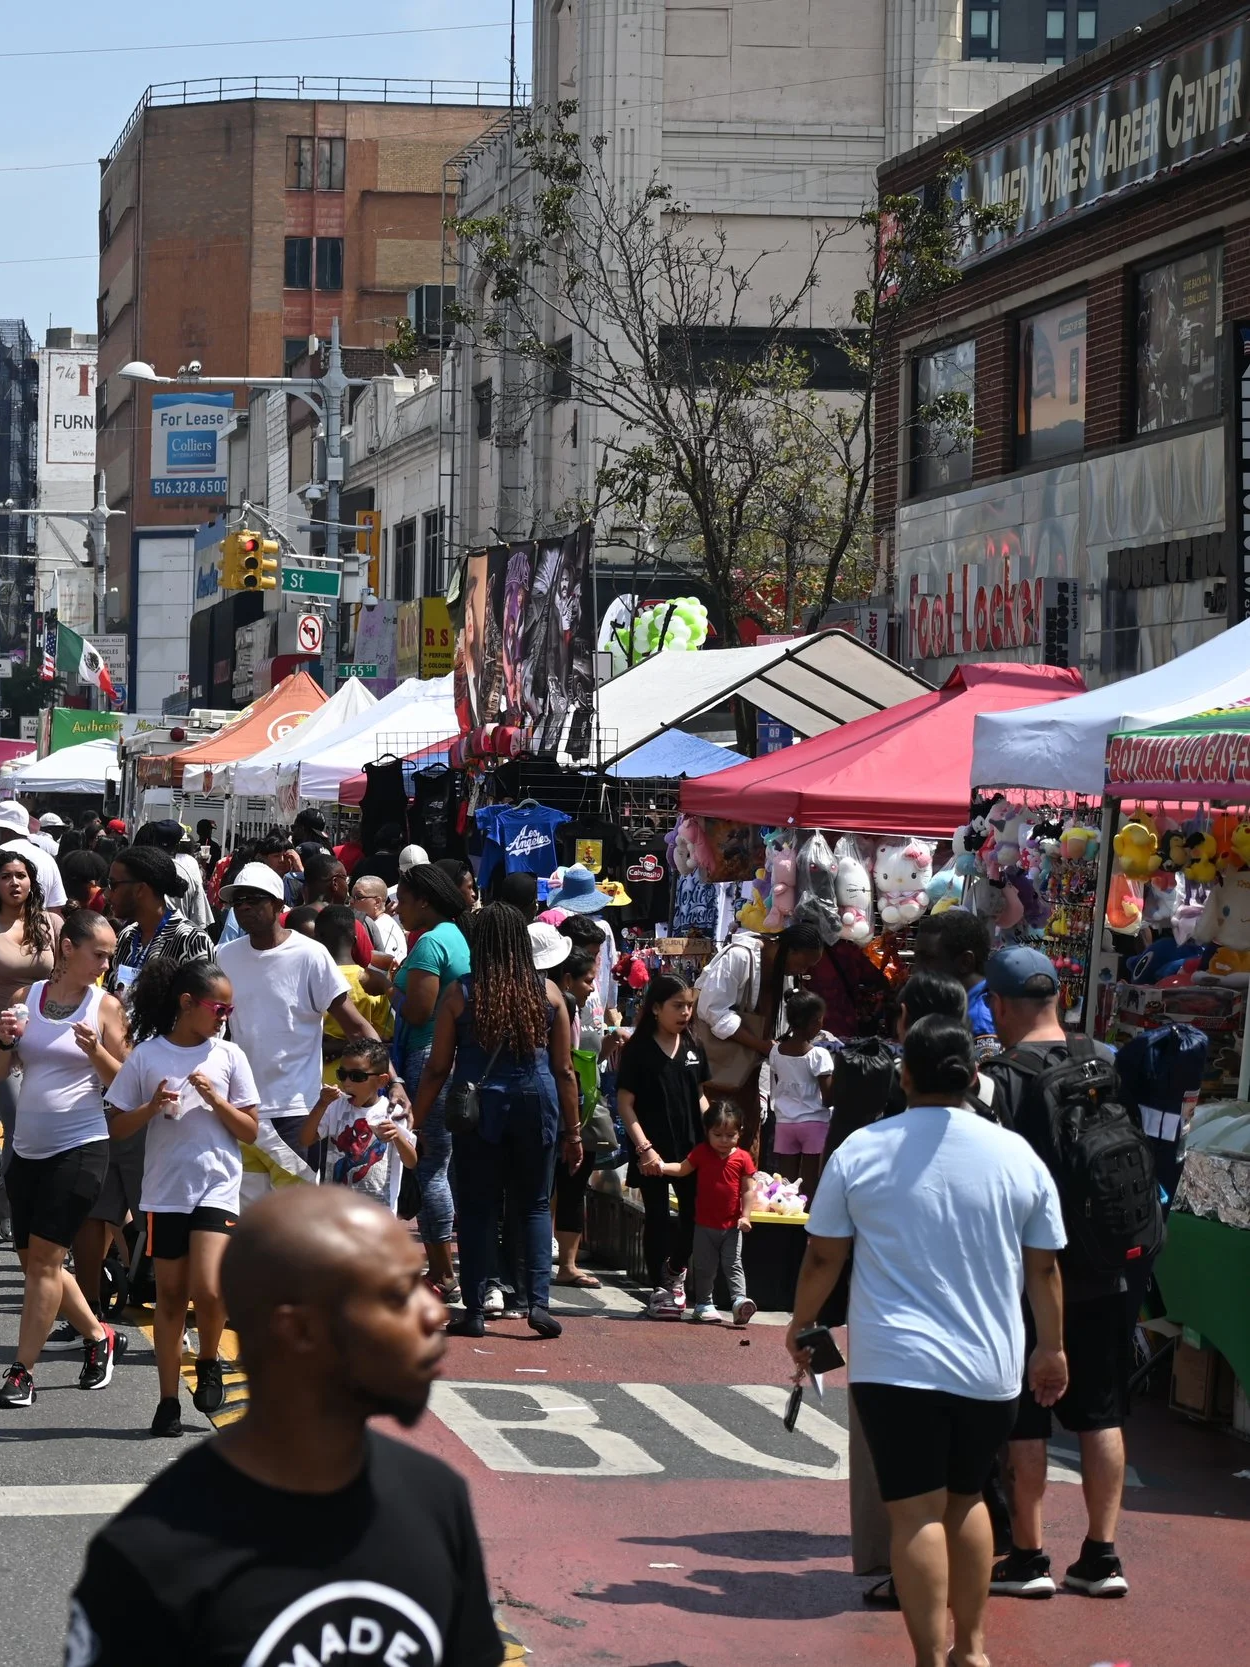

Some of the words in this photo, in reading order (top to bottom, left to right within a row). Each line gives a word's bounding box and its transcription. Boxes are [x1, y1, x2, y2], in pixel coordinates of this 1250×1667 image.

[1032, 132, 1091, 211] FORCES
[1095, 98, 1160, 181] CAREER
[1165, 59, 1242, 149] CENTER
[55, 366, 76, 380] The
[160, 413, 182, 427] For
[185, 412, 224, 426] Lease
[171, 438, 212, 451] Colliers
[154, 480, 227, 495] 516.328.6500
[290, 572, 305, 589] St
[908, 572, 956, 660] Foot
[961, 555, 1044, 652] Locker
[865, 610, 878, 650] ocker
[344, 665, 364, 677] 165
[365, 664, 374, 673] St
[520, 824, 539, 840] Los
[505, 832, 552, 856] Angeles
[276, 1616, 420, 1667] MADE
